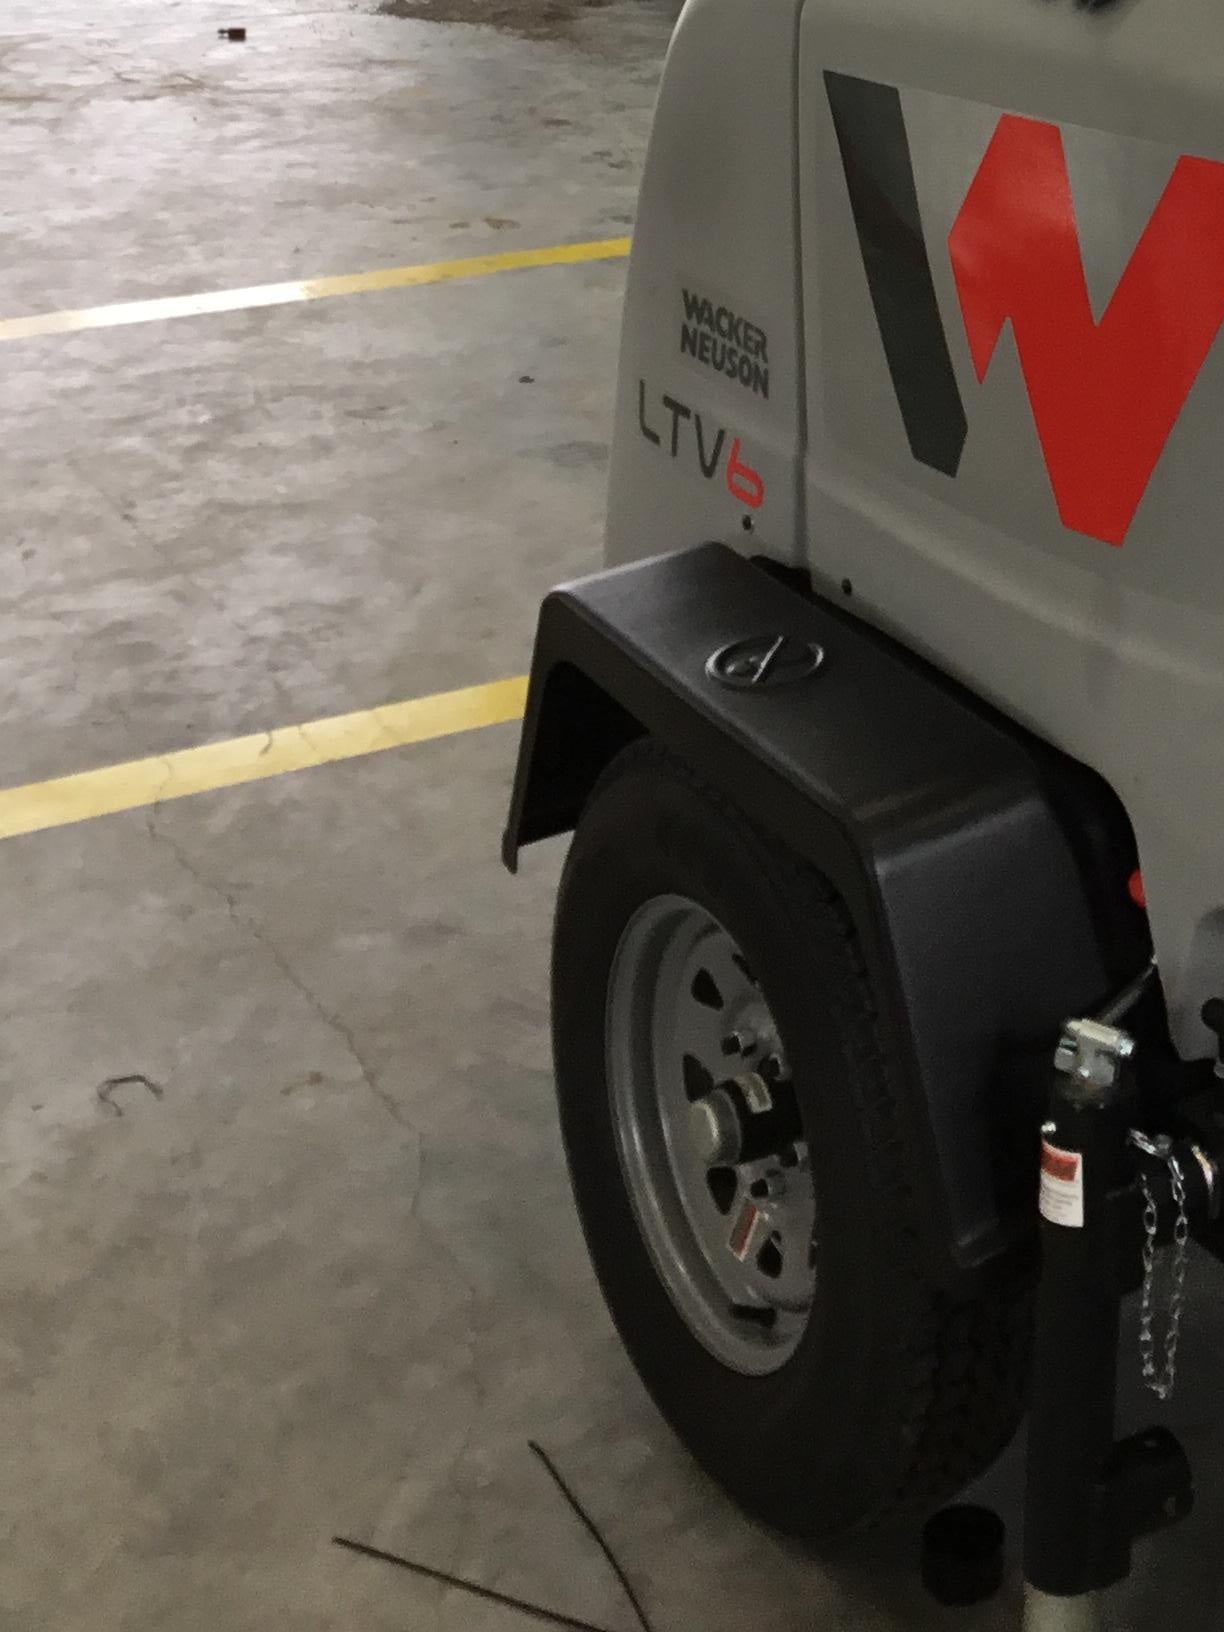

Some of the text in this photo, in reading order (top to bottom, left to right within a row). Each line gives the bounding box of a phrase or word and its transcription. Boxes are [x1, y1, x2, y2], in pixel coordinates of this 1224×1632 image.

[680, 323, 769, 400] NEUSON
[682, 288, 769, 363] WACKER
[638, 378, 765, 509] LTV6
